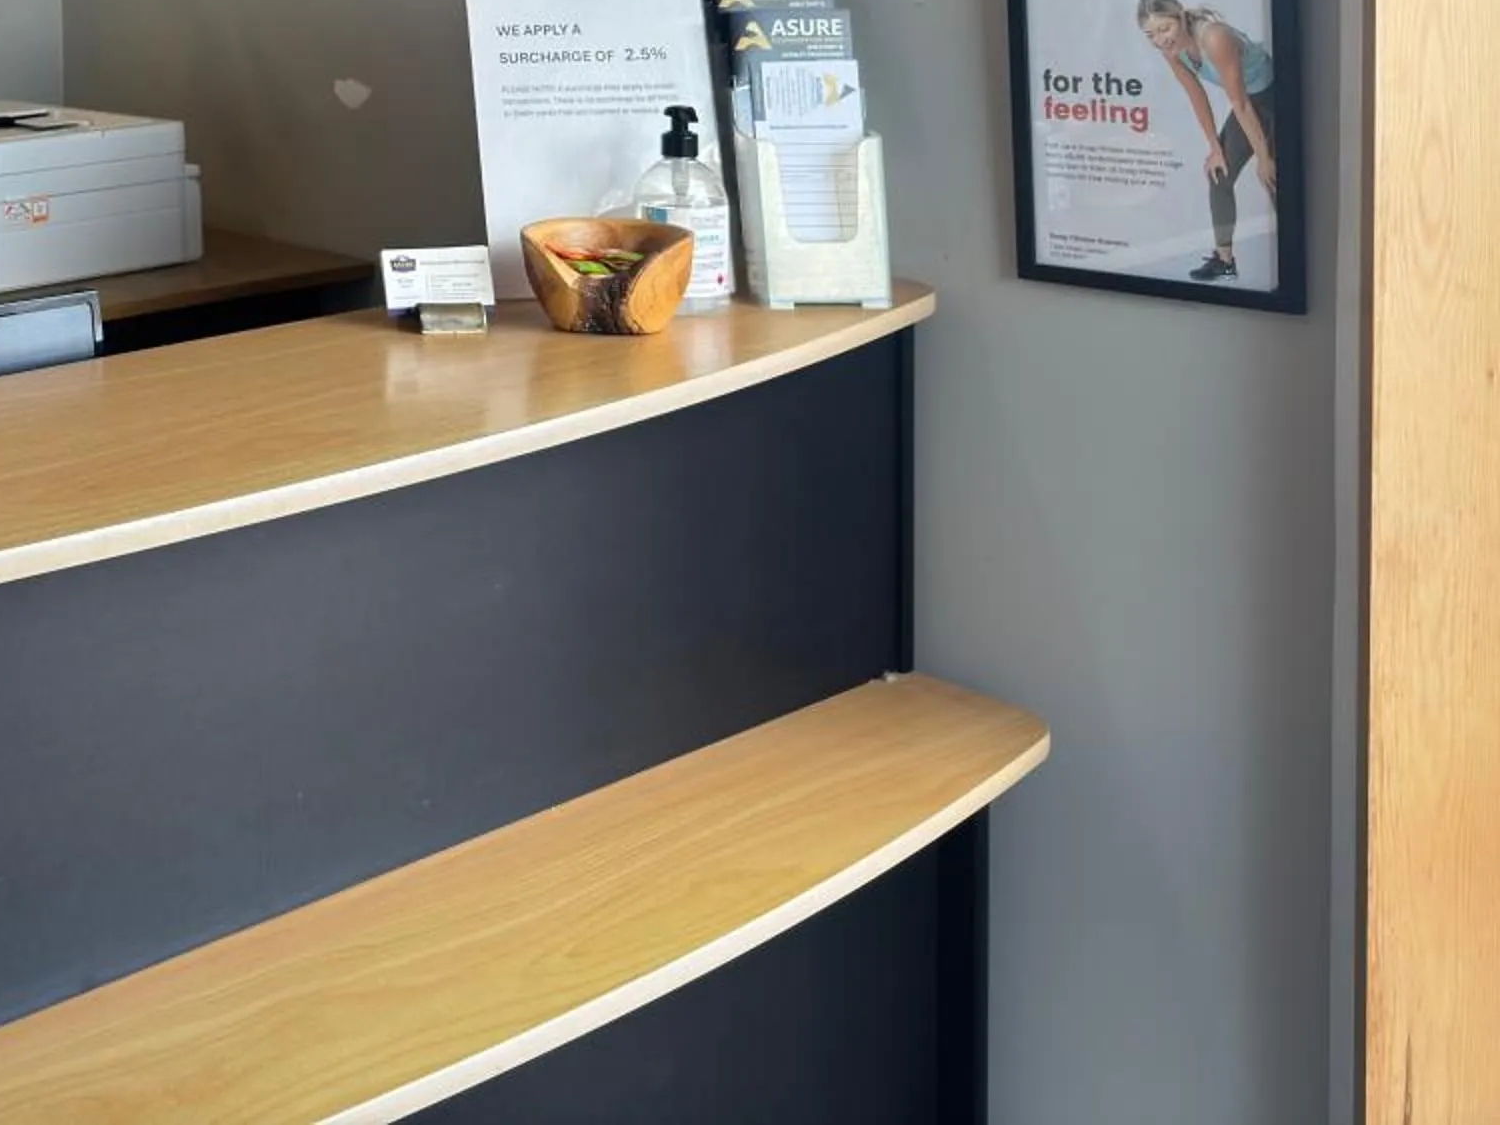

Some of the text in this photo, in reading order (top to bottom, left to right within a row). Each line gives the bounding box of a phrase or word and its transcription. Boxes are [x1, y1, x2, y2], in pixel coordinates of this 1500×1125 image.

[496, 23, 582, 37] WE APPLY A
[771, 19, 843, 36] ASURE
[499, 46, 667, 65] SURCHARGE OF 2.5%
[1043, 68, 1143, 96] for the
[1044, 95, 1149, 133] feeling
